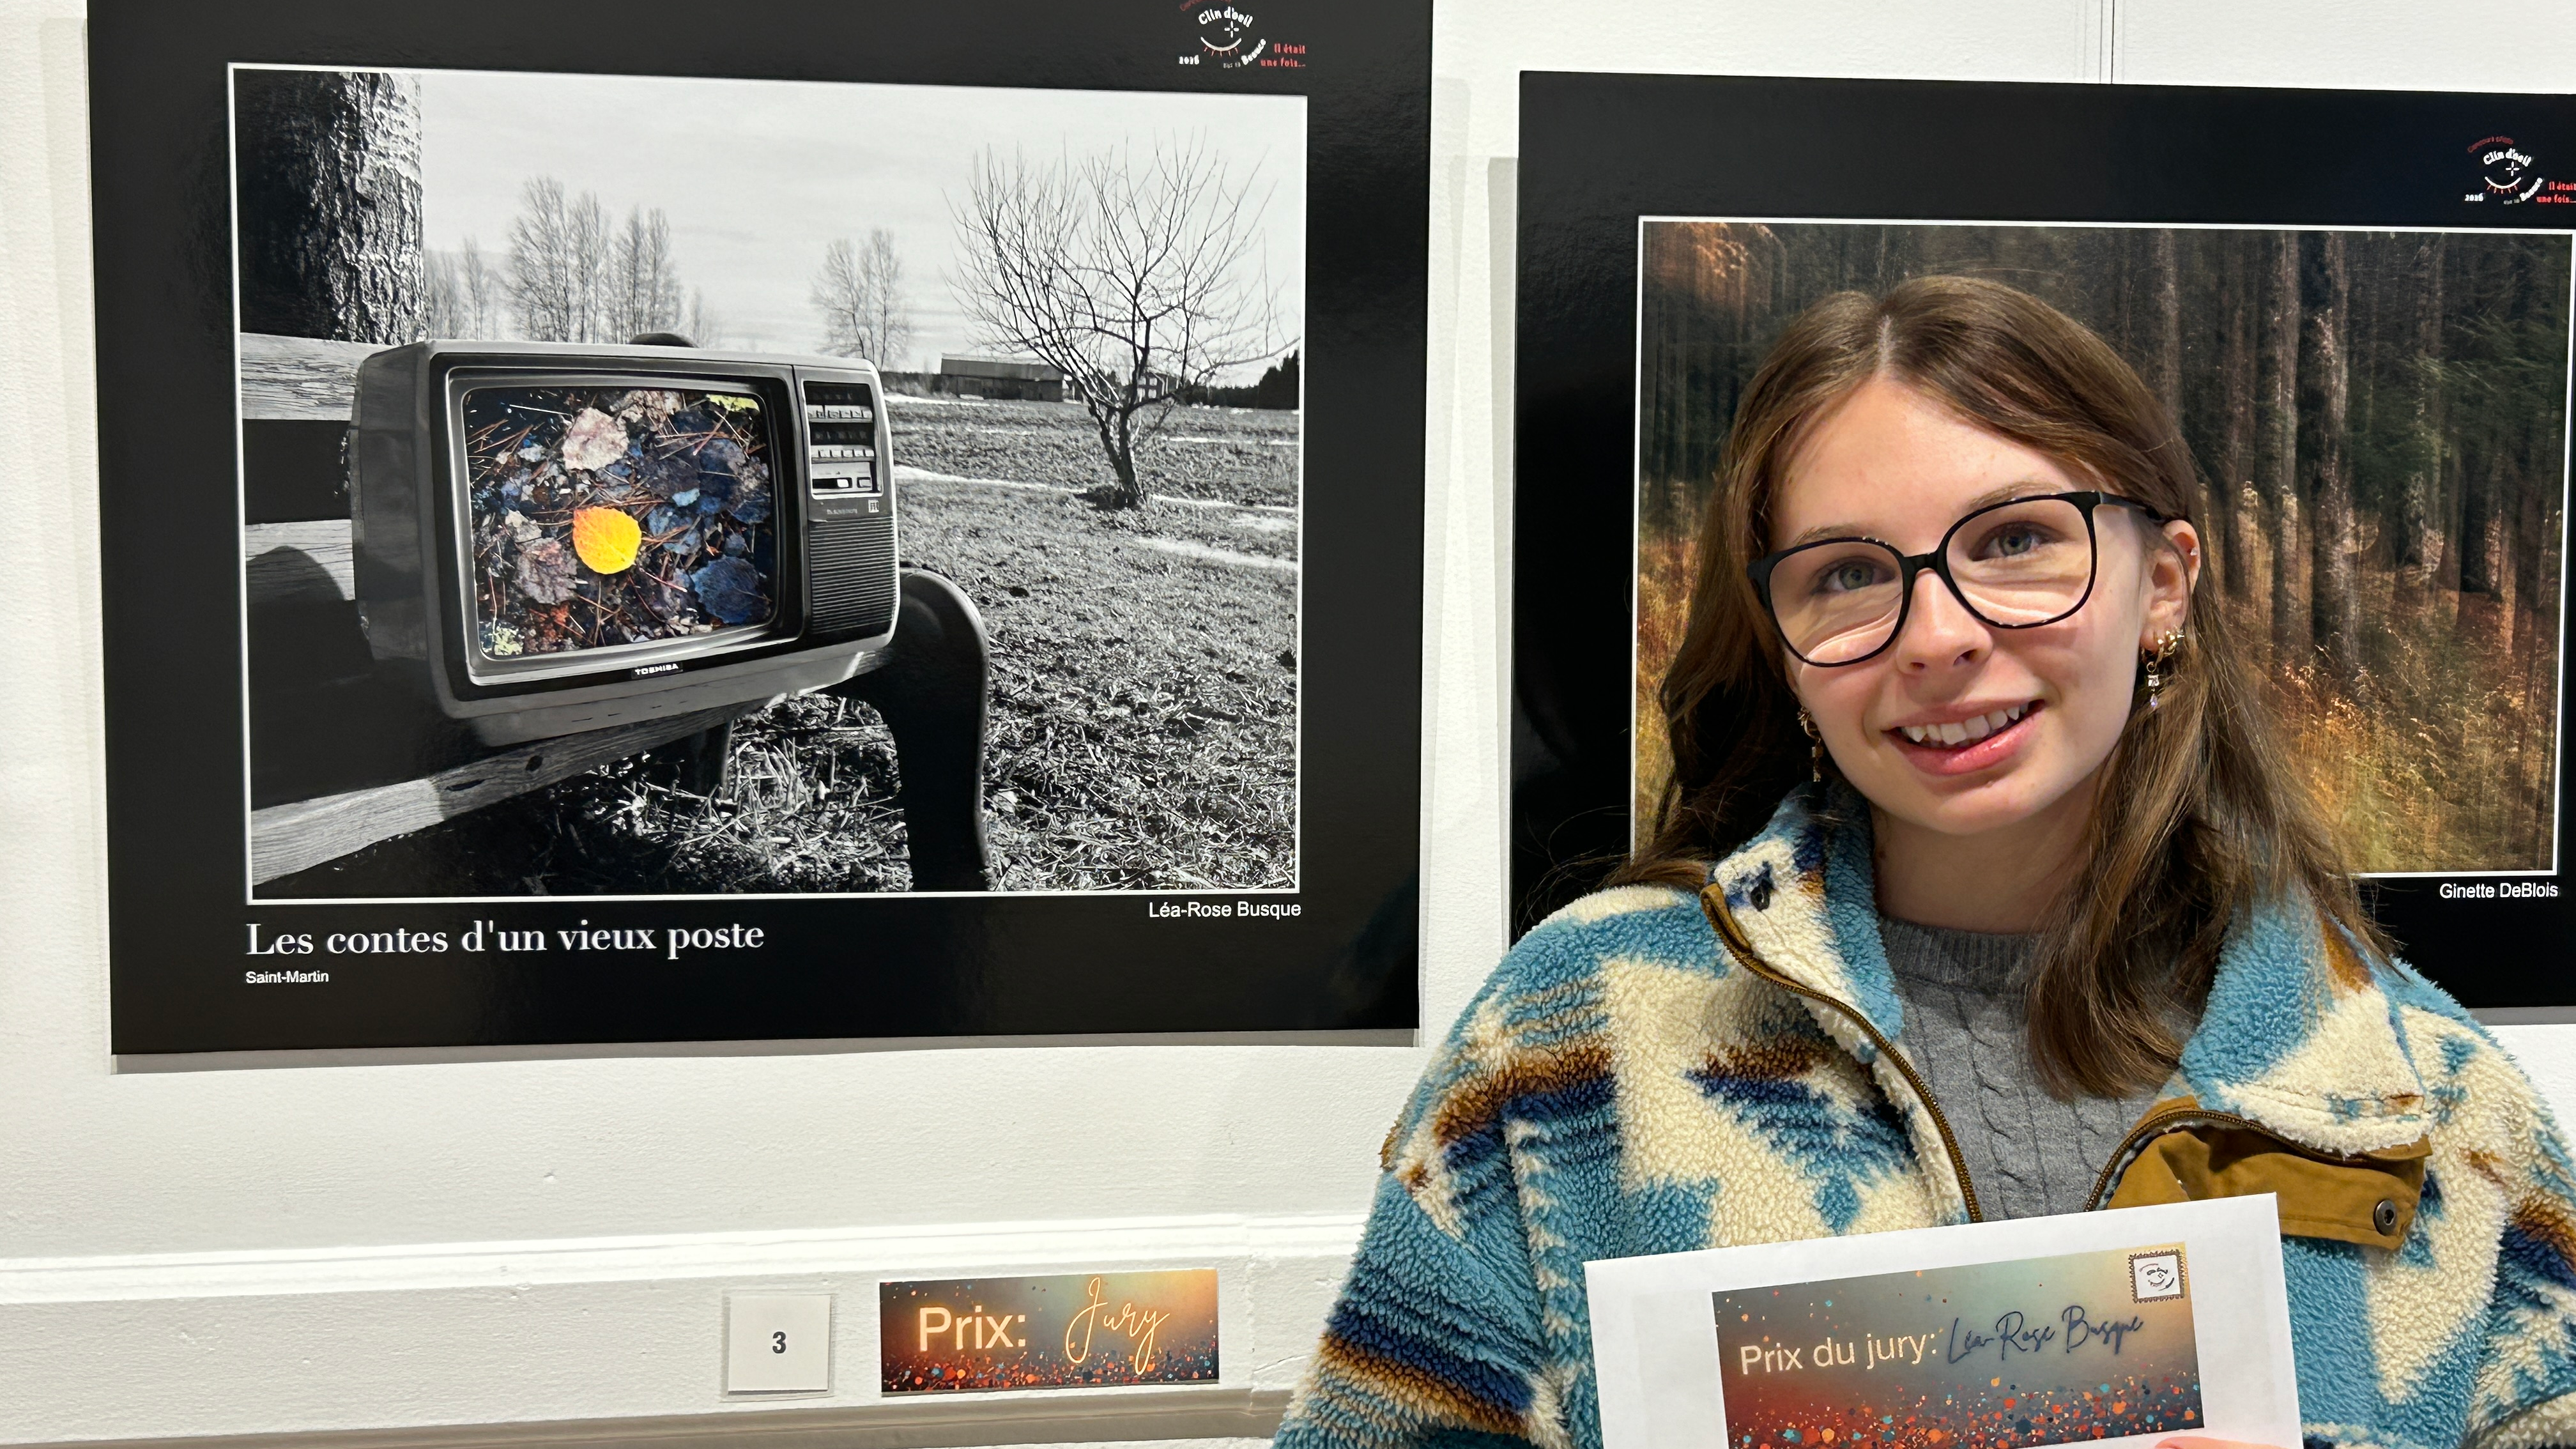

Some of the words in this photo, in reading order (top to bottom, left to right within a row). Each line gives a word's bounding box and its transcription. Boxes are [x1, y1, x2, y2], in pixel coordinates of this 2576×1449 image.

[1198, 9, 1222, 25] Clin
[2483, 150, 2504, 165] Clin
[634, 663, 678, 675] TOSHIBA
[2439, 883, 2496, 899] Ginette
[2499, 882, 2559, 898] DeBlois
[1149, 901, 1232, 918] Léa-Rose
[1237, 901, 1301, 921] Busque
[245, 923, 314, 956] Les
[326, 927, 448, 954] contes
[461, 919, 548, 953] d'un
[557, 919, 657, 951] vieux
[667, 922, 765, 960] poste
[245, 970, 329, 985] Saint-Martin
[919, 1305, 1027, 1353] Prix:
[1066, 1276, 1170, 1376] Jury
[772, 1331, 786, 1354] 3
[1740, 1342, 1803, 1375] Prix
[1813, 1337, 1855, 1367] du
[1866, 1333, 1936, 1370] jury:
[2062, 1305, 2143, 1355] Busque
